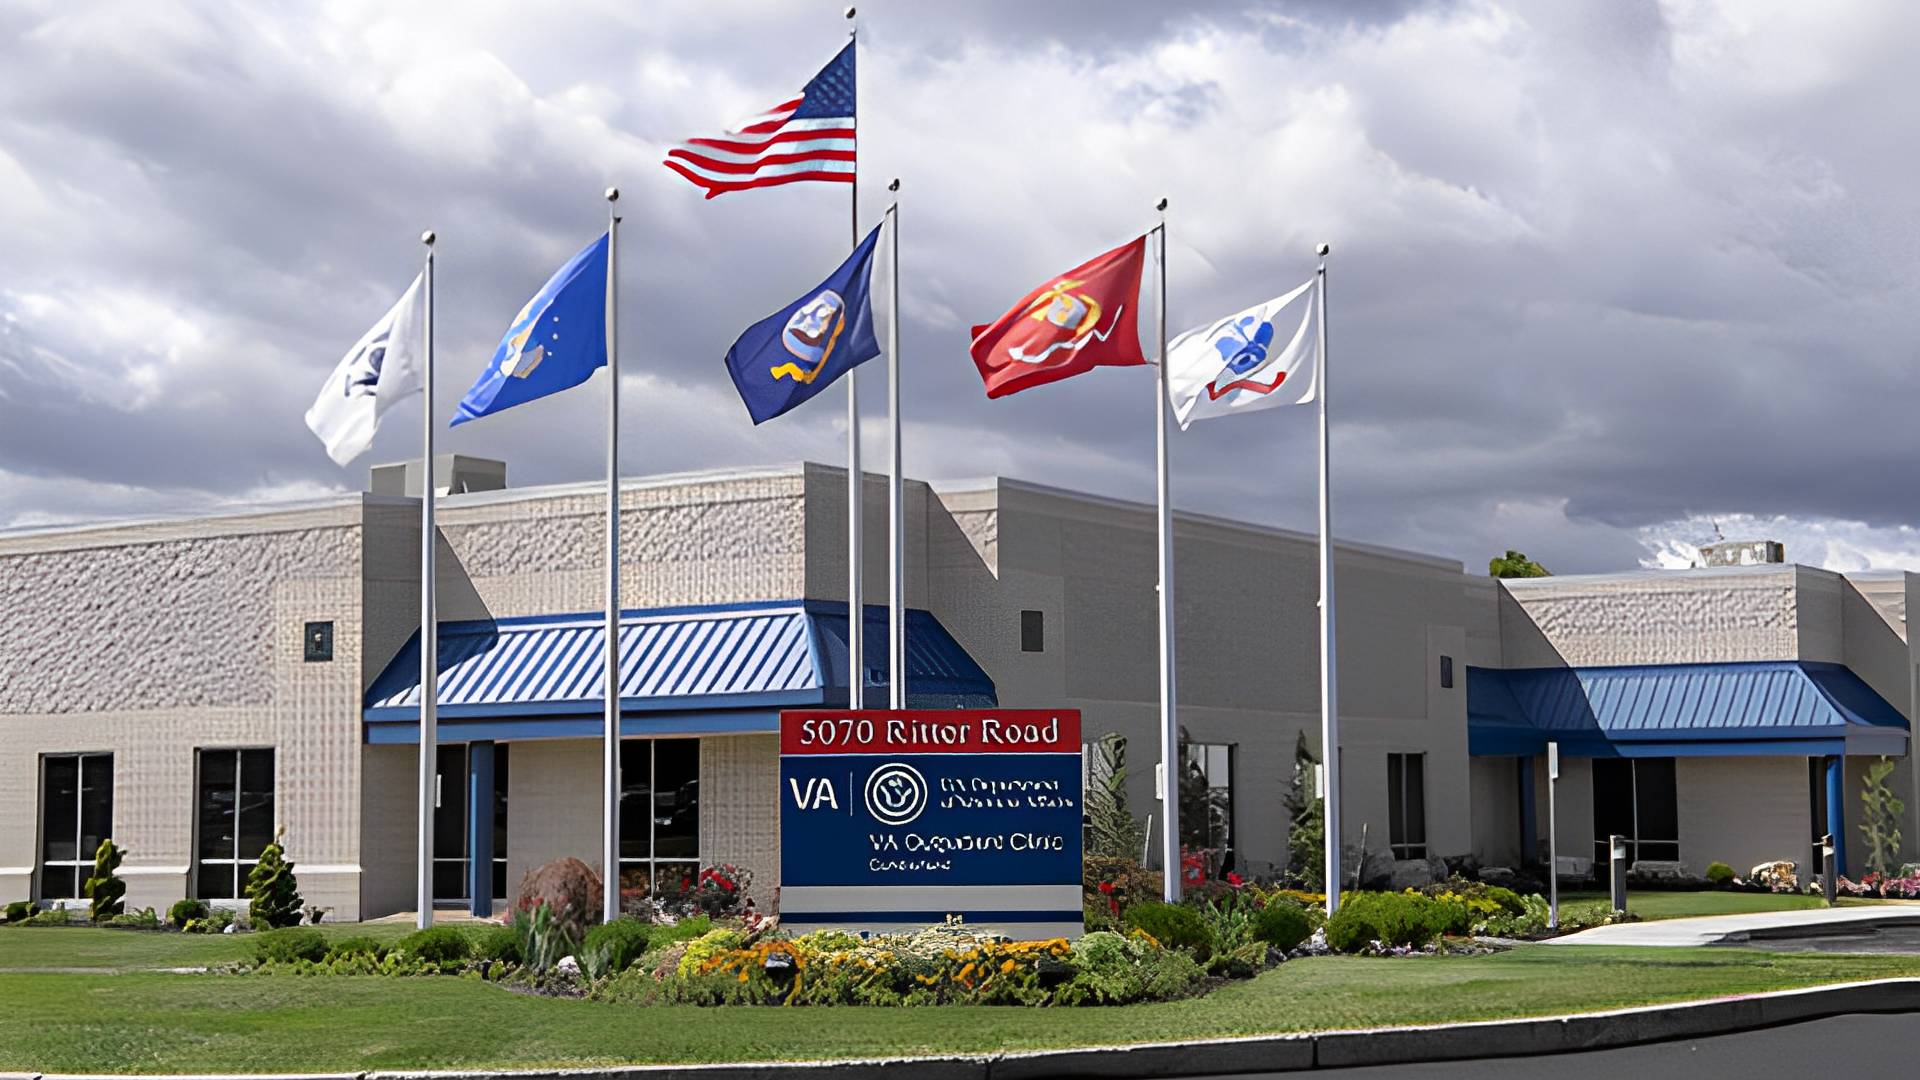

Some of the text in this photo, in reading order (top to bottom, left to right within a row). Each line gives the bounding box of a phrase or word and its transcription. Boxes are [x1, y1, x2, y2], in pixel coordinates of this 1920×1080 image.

[800, 719, 874, 746] 5070
[982, 717, 1058, 744] Road
[789, 777, 839, 810] VA
